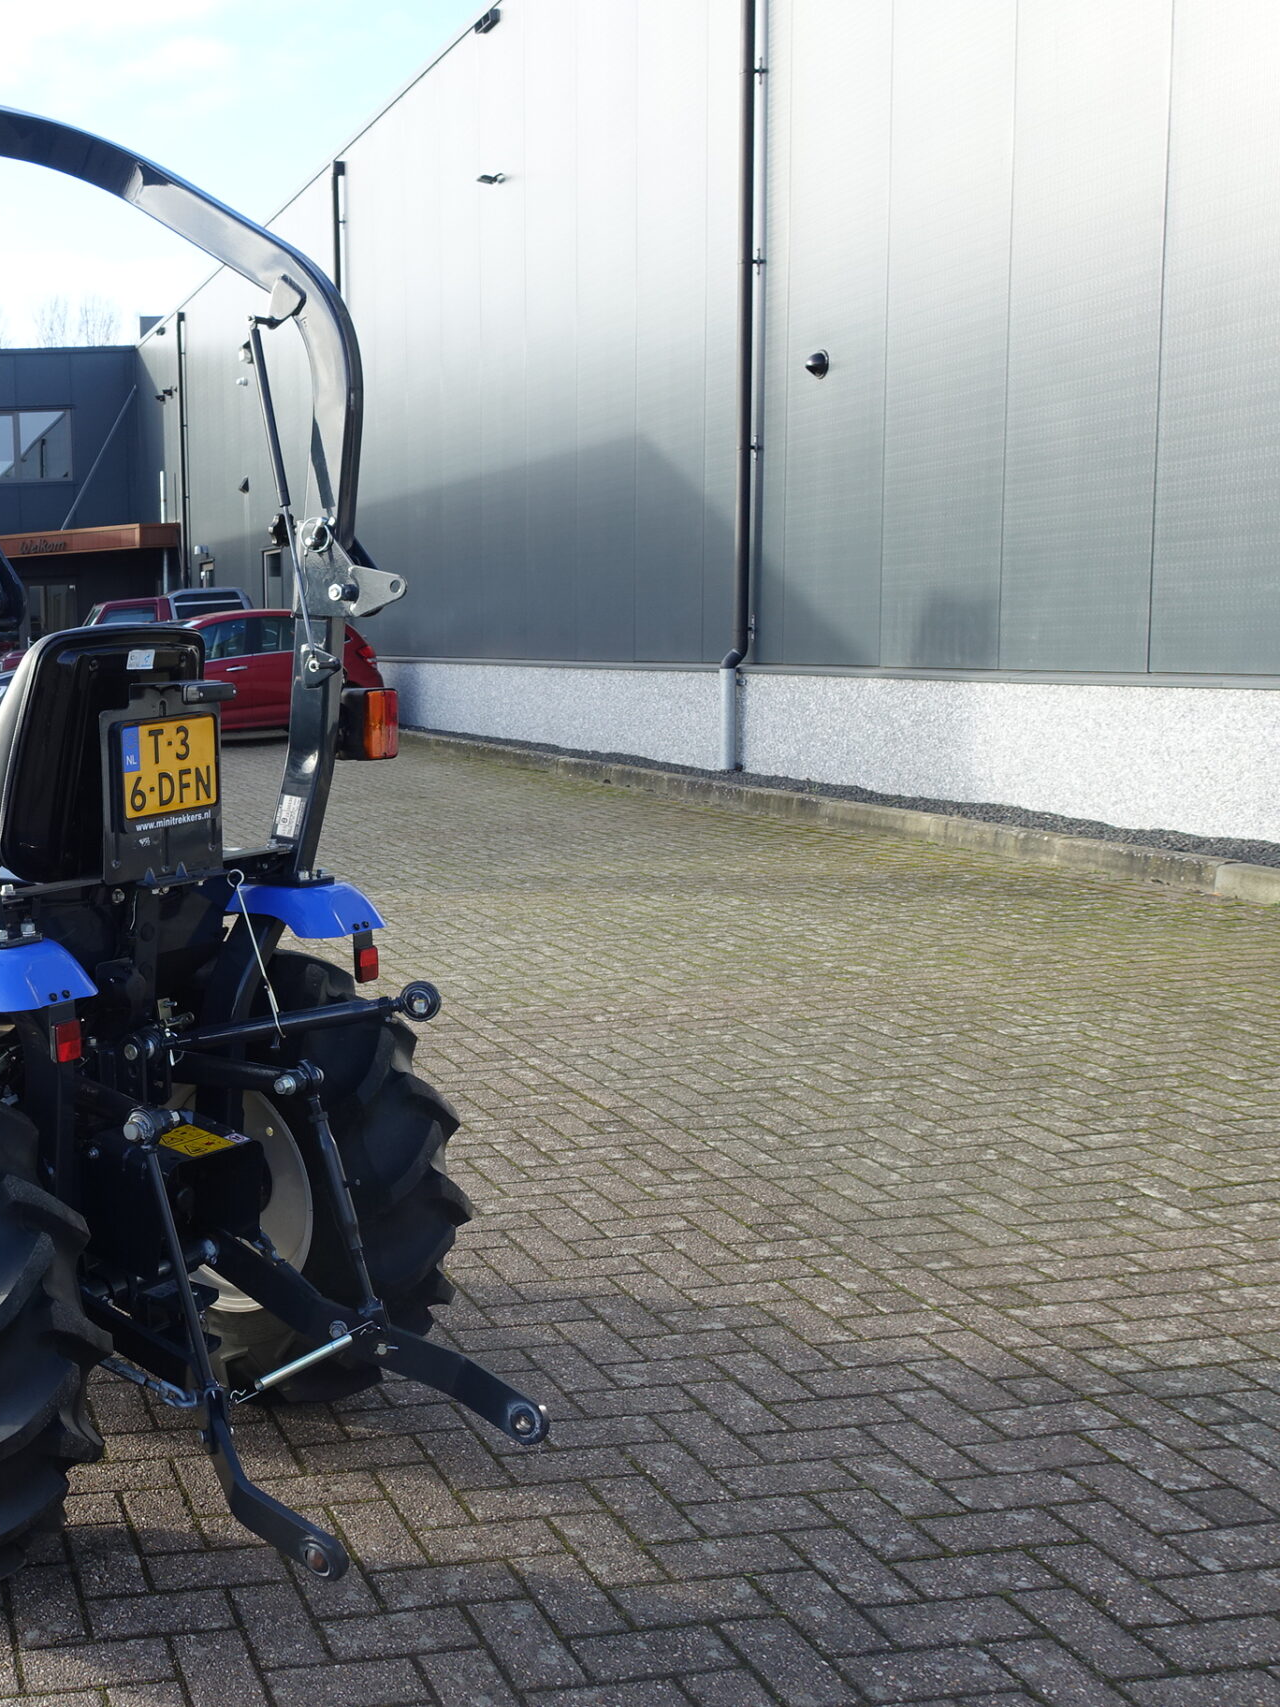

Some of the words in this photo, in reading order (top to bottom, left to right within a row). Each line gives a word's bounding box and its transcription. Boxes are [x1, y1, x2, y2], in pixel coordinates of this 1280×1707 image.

[21, 537, 67, 555] Welkom
[126, 754, 138, 766] NL
[135, 810, 211, 832] www.minitrekkers.nl
